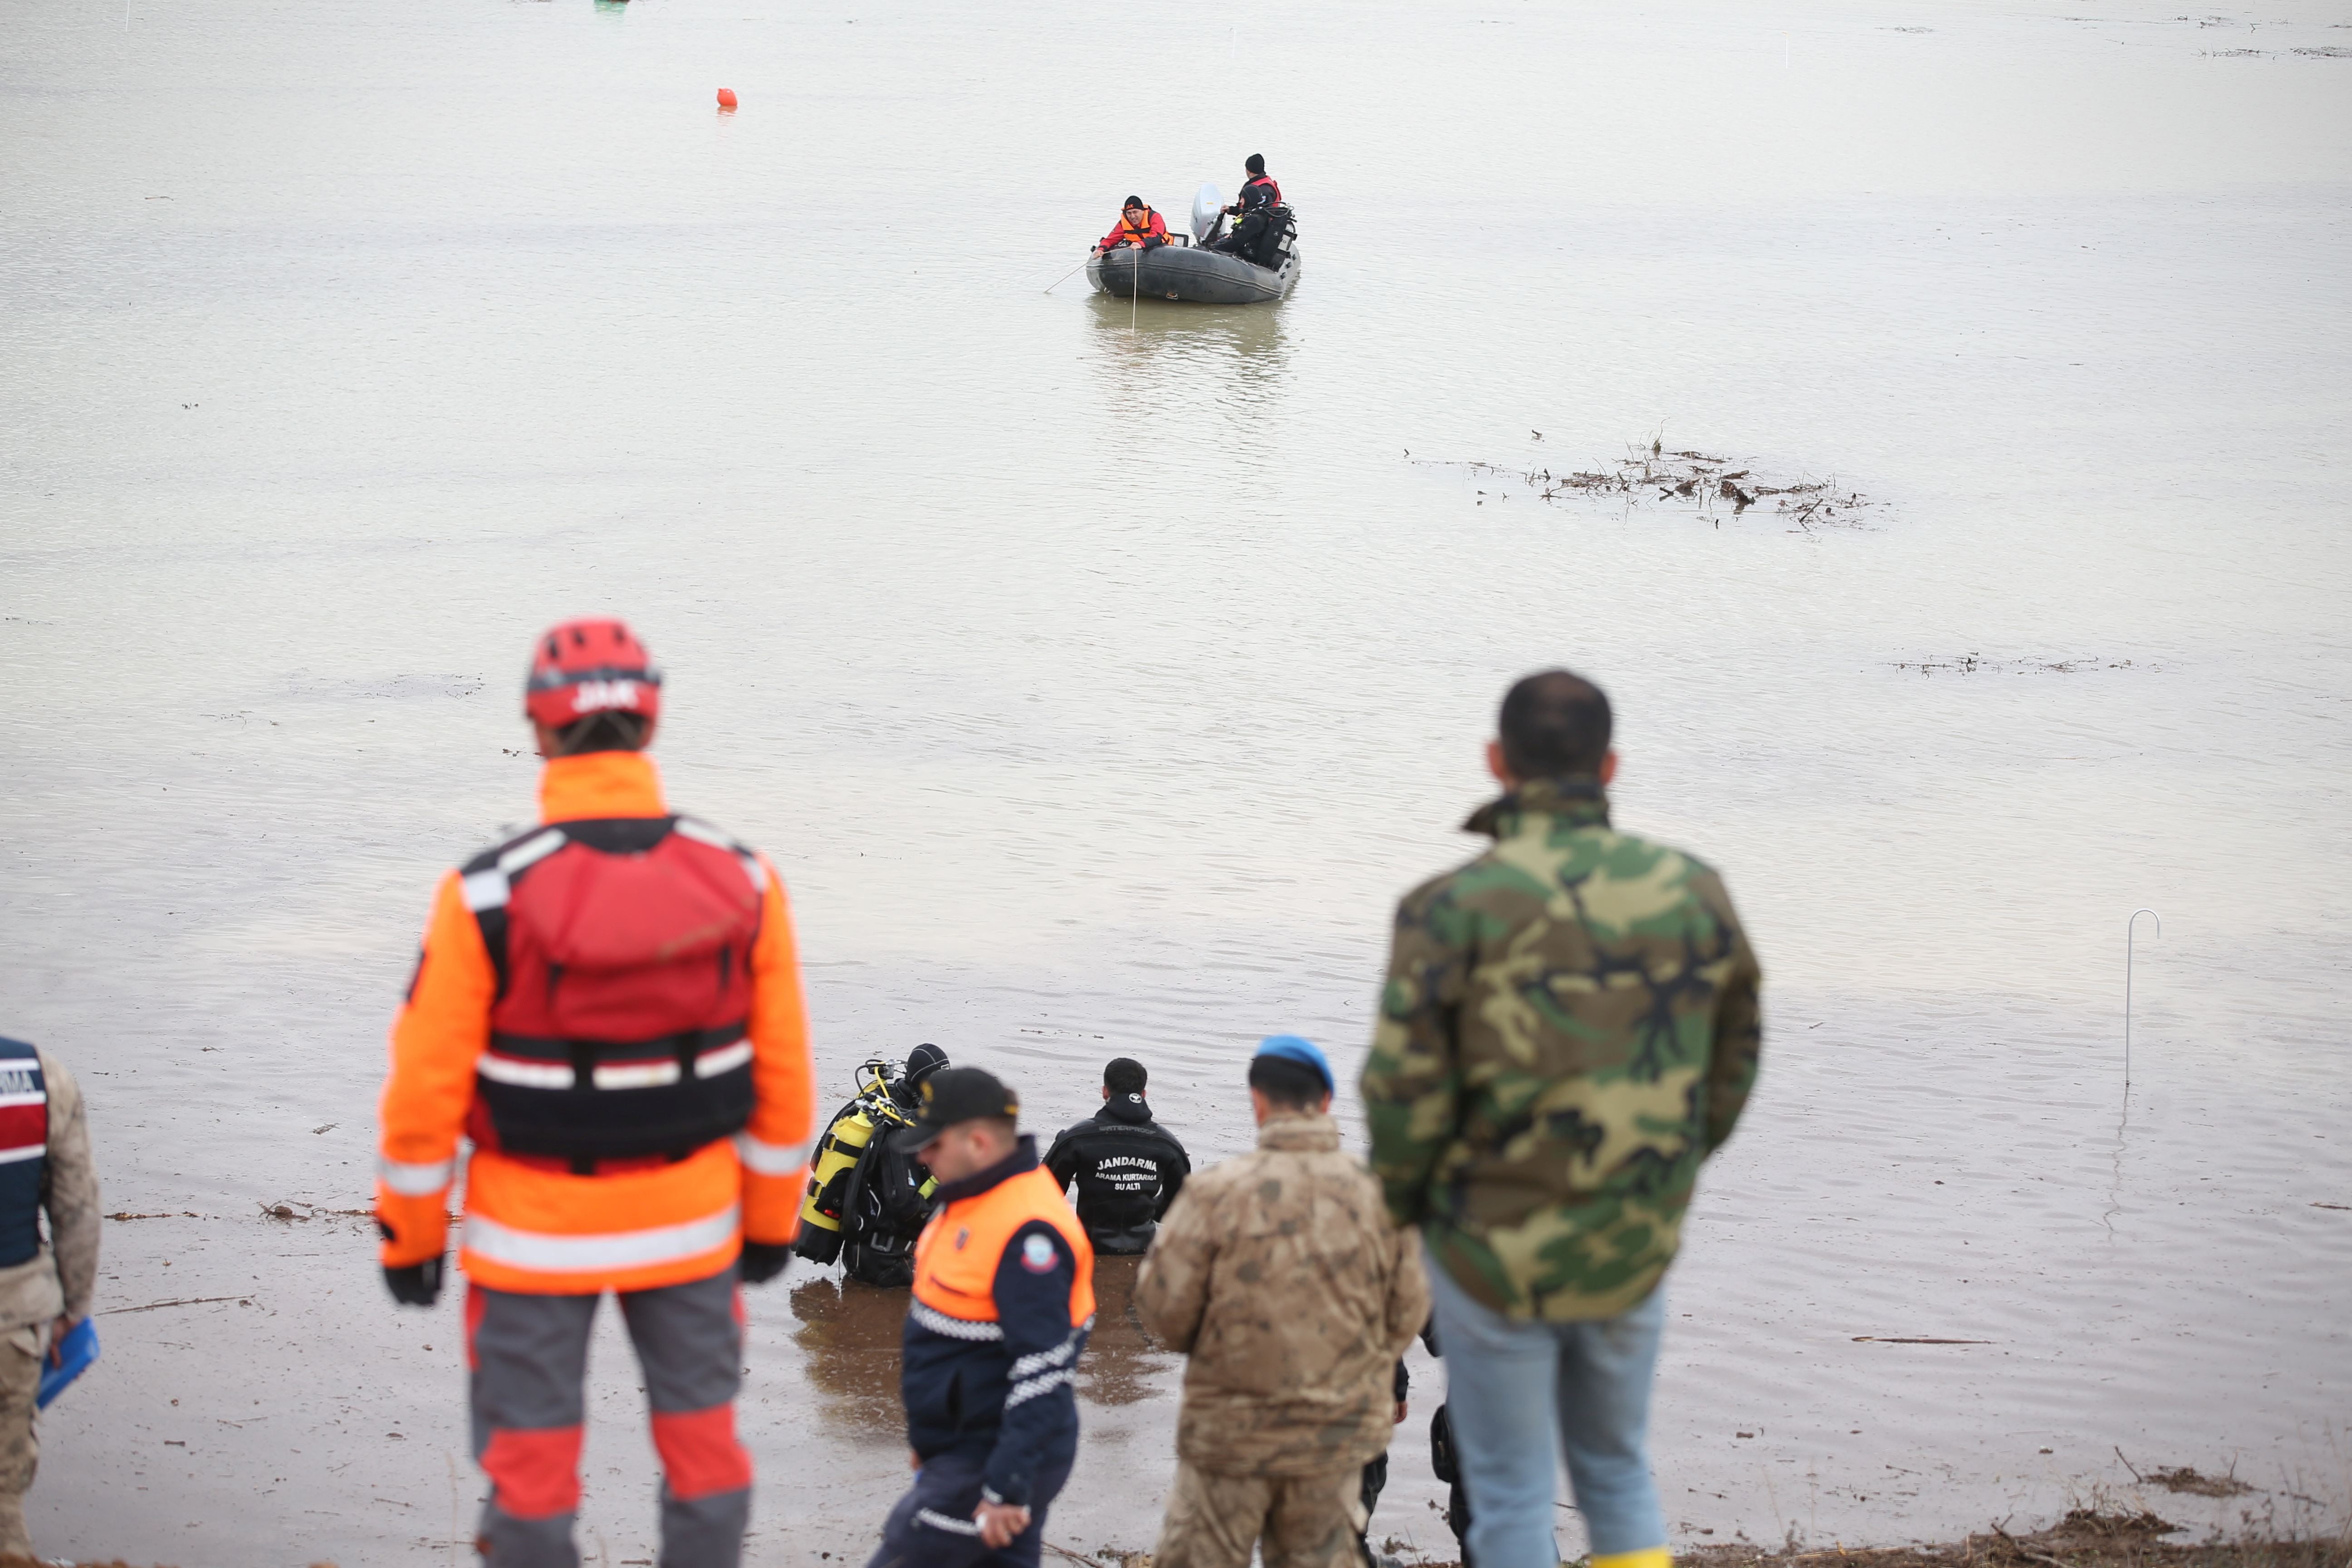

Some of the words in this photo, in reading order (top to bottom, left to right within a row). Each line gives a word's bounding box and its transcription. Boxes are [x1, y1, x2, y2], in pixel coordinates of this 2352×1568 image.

[571, 681, 639, 712] JAK
[1099, 1125, 1156, 1134] WATERPROOF
[1097, 1156, 1157, 1171] JANDARMA
[1095, 1172, 1121, 1181] ARAMA
